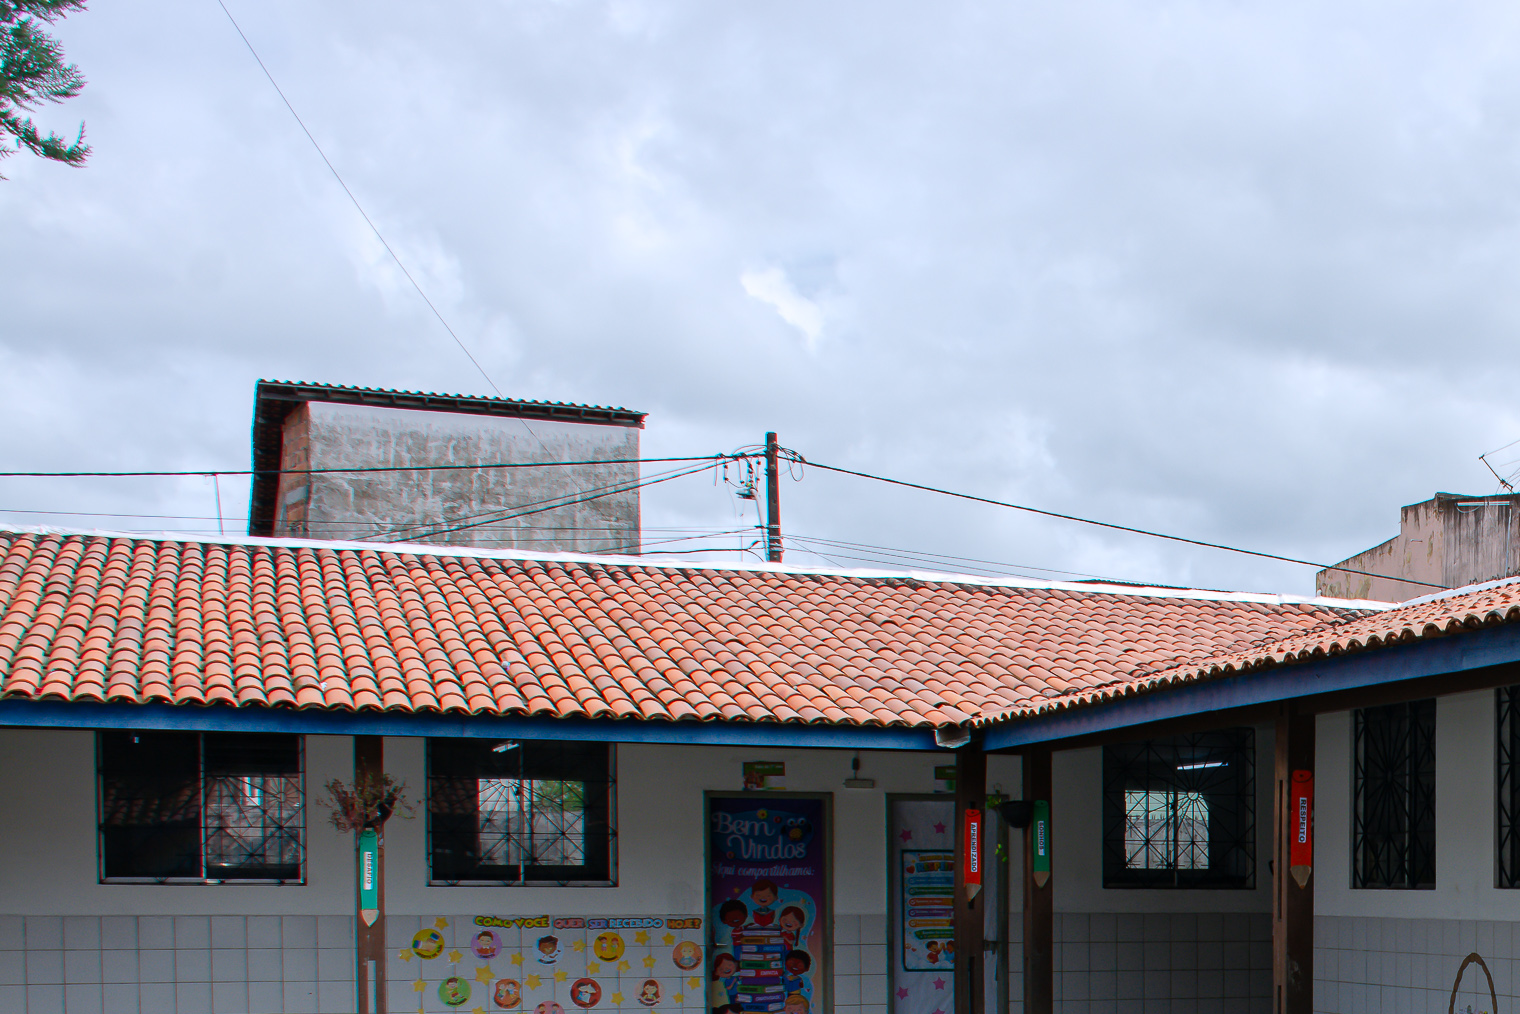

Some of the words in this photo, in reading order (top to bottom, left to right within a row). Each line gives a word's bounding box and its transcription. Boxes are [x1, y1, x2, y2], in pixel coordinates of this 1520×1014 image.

[711, 811, 775, 836] Bem
[1299, 799, 1307, 842] RESPEITO
[726, 835, 806, 859] Vindos
[738, 864, 816, 879] compartilhamos:
[474, 916, 513, 929] COMO
[554, 917, 586, 930] QUER
[587, 917, 609, 930] SER
[608, 917, 664, 929] RECEBIDO
[666, 917, 702, 930] HOJE?
